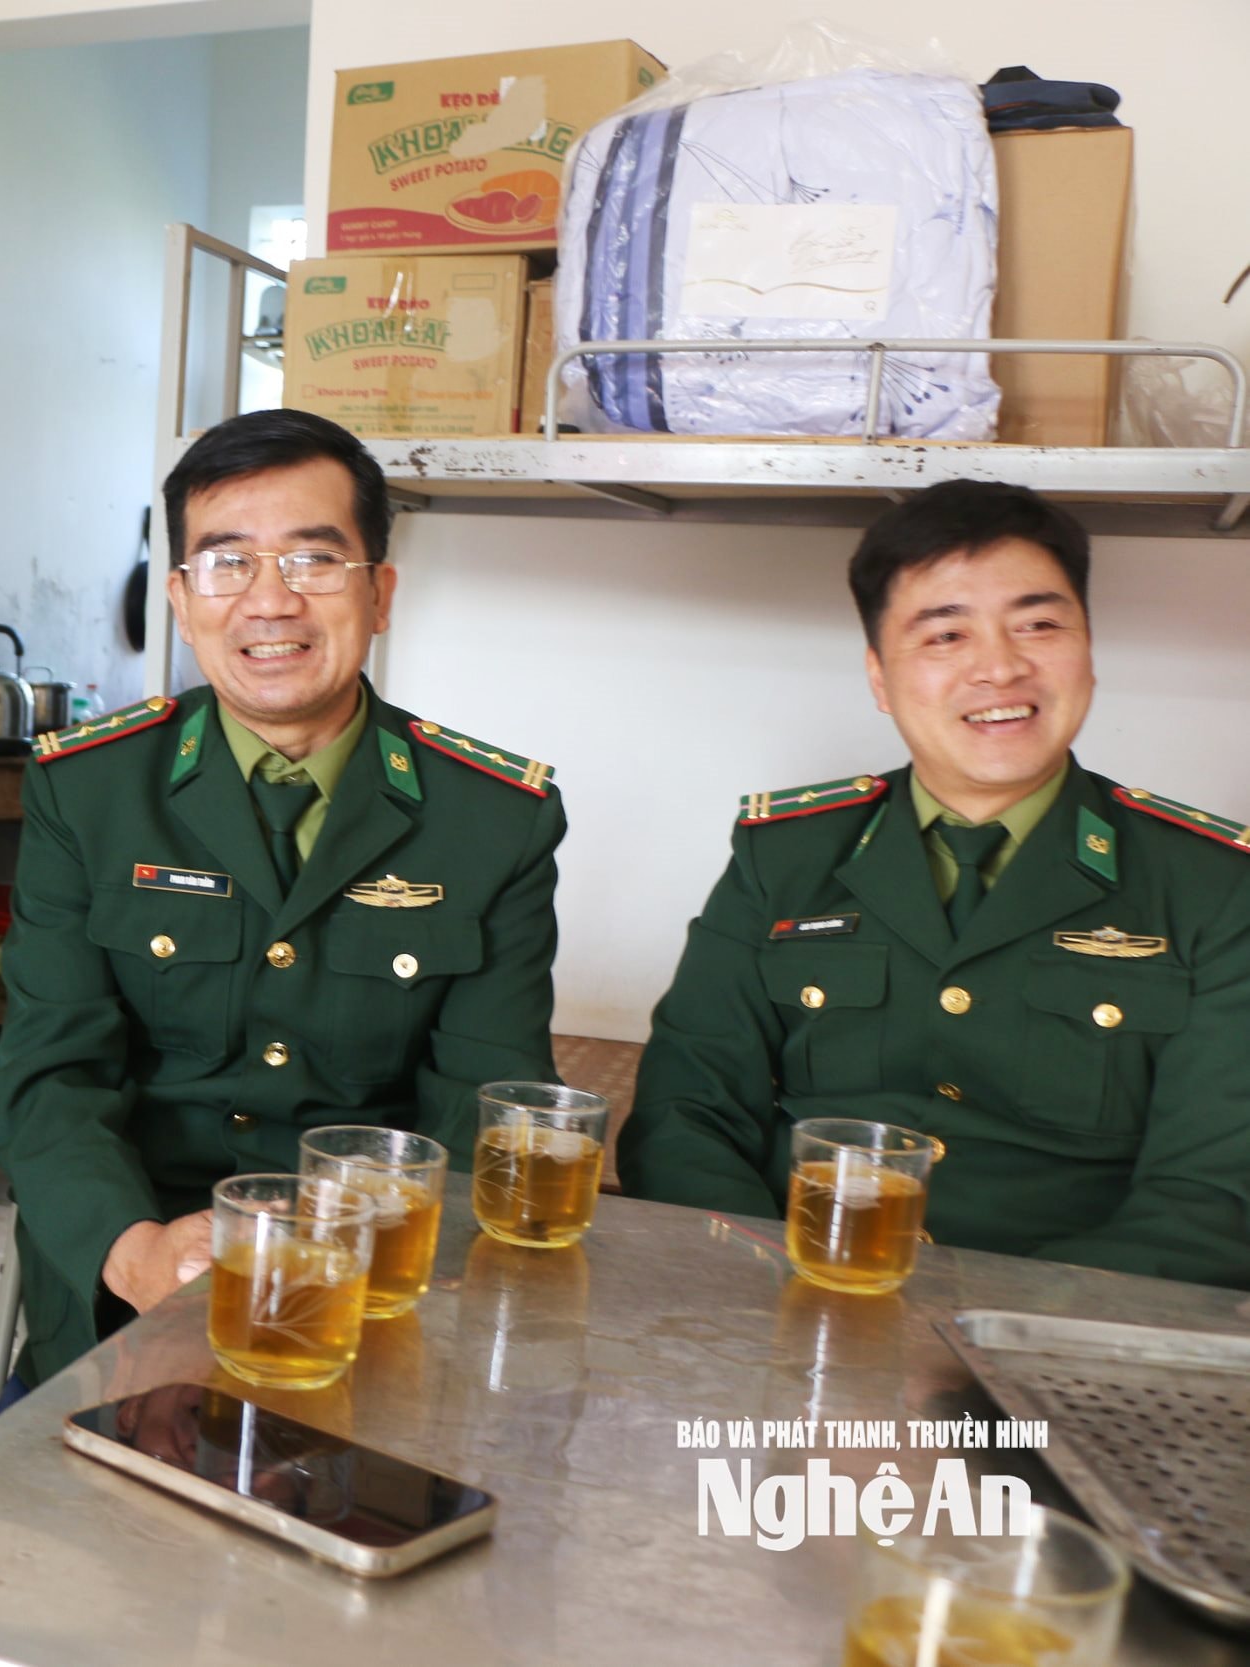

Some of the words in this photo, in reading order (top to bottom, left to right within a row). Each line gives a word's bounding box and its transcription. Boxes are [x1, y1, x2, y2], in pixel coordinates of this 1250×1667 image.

[440, 93, 472, 111] KẸO
[390, 166, 431, 192] SWEET
[435, 158, 488, 177] POTATO
[353, 356, 388, 371] SWEET
[392, 355, 437, 369] POTATO
